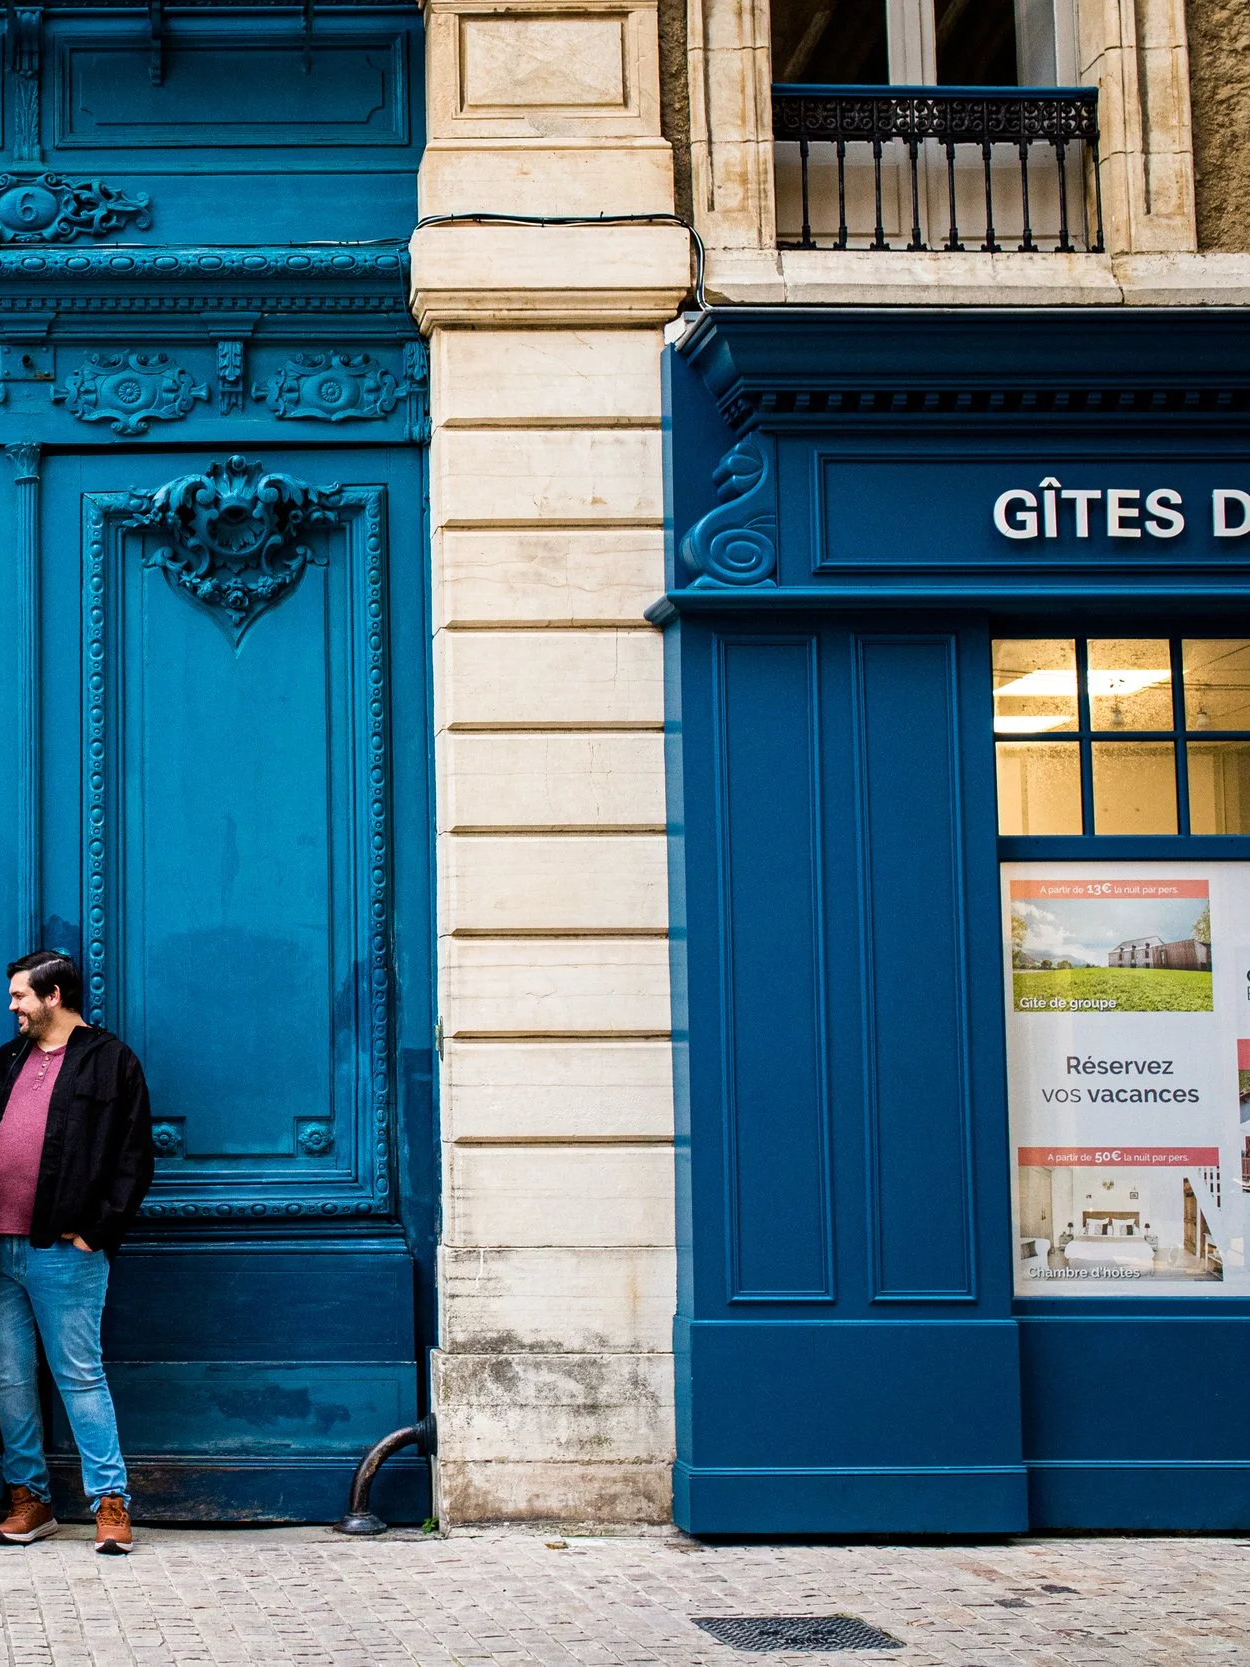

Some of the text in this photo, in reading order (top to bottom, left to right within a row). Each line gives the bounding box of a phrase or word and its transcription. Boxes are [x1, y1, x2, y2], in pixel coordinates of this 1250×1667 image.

[993, 477, 1185, 539] GÎTES
[1048, 885, 1071, 896] partir
[1072, 885, 1083, 894] de
[1087, 883, 1112, 895] 13€
[1114, 885, 1122, 894] la
[1124, 885, 1141, 894] nuit
[1143, 887, 1157, 896] par
[1050, 997, 1067, 1008] de
[1070, 999, 1117, 1011] groupe
[1066, 1056, 1174, 1075] Réservez
[1041, 1088, 1200, 1104] vos vacances
[1056, 1153, 1078, 1163] partir
[1080, 1153, 1092, 1162] de
[1095, 1150, 1121, 1163] 50€
[1124, 1153, 1132, 1162] la
[1134, 1153, 1150, 1162] nuit
[1152, 1155, 1167, 1163] par
[1168, 1155, 1190, 1163] pers.
[1029, 1266, 1088, 1278] Chambre
